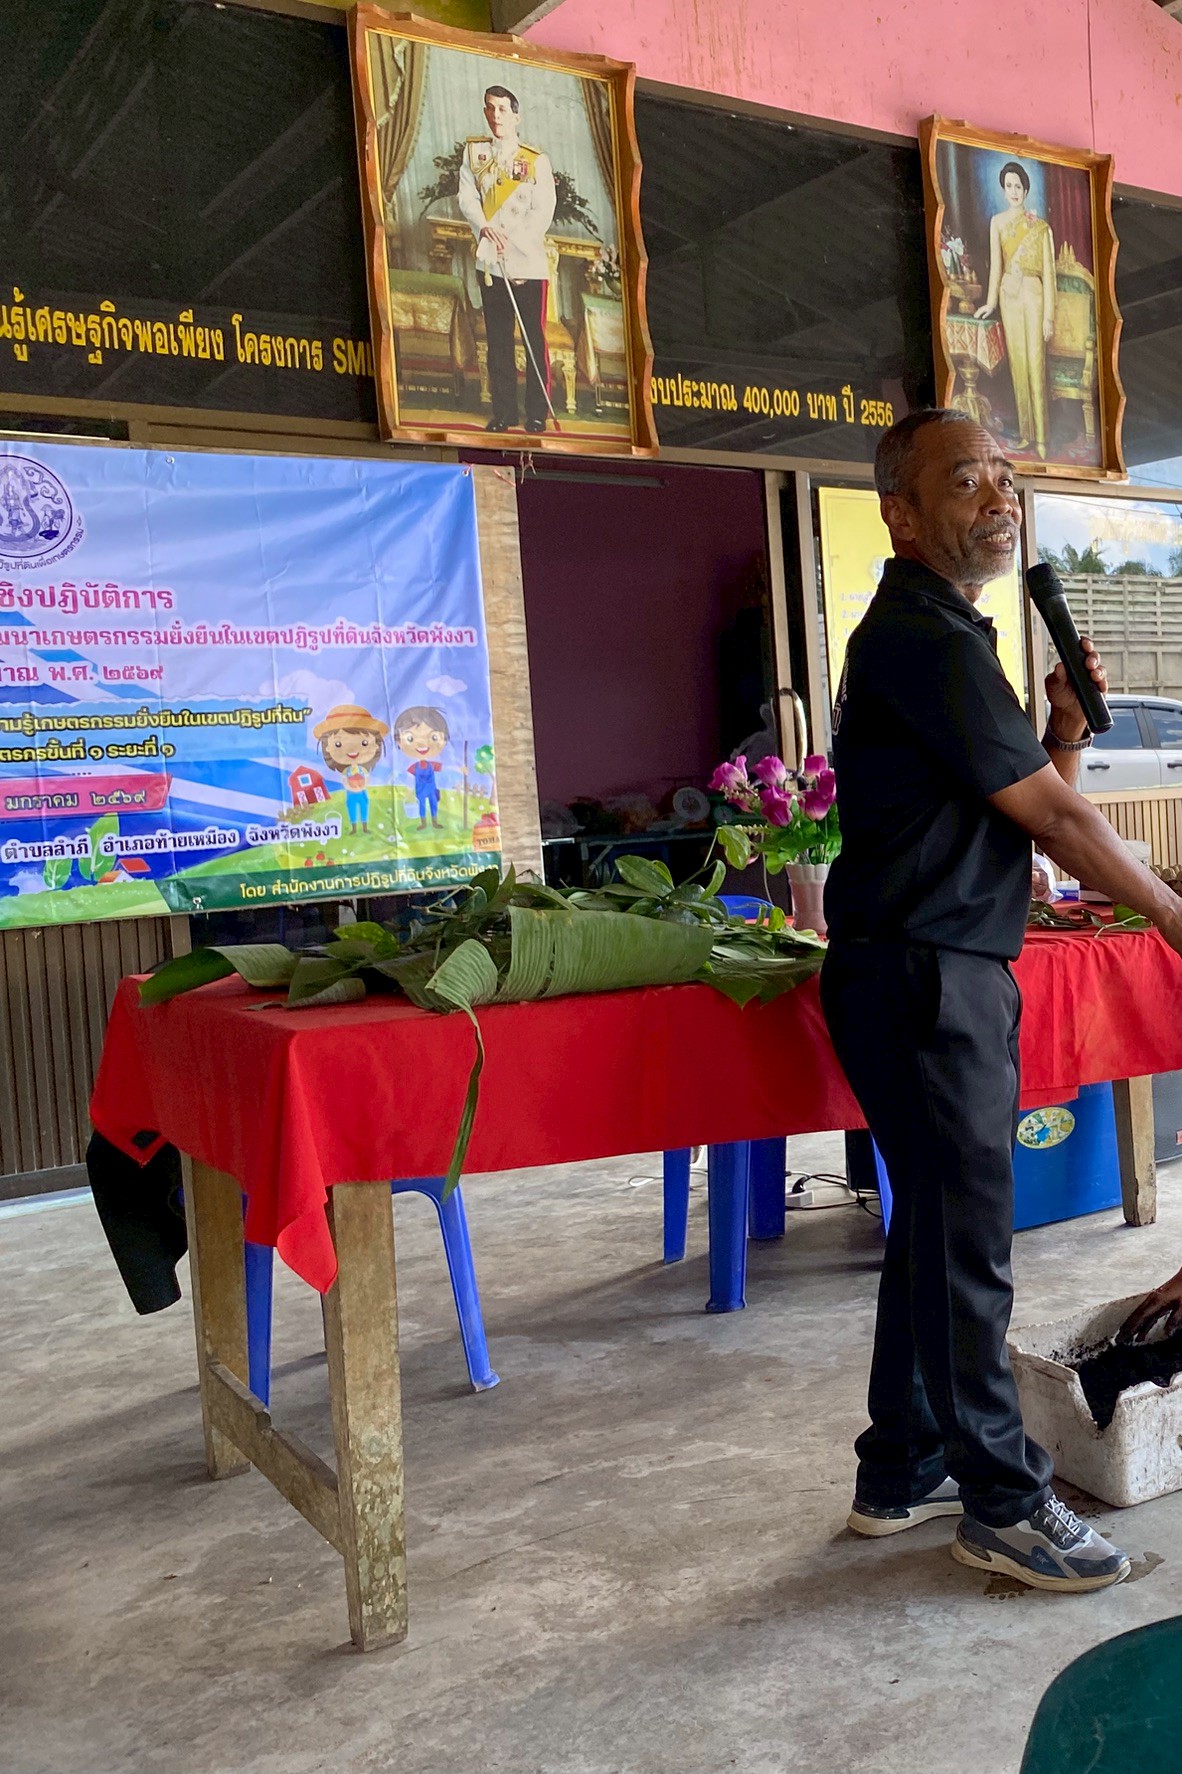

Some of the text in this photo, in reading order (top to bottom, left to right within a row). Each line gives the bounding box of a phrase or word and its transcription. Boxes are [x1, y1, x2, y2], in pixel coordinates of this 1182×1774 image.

[232, 313, 323, 371] โครงการ
[650, 373, 738, 411] งบประมาณ
[743, 386, 800, 418] 400,000
[807, 392, 837, 421] บาท
[842, 384, 854, 423] ปี
[861, 399, 894, 427] 2556
[0, 664, 164, 681] าณ พ.ศ. ๒๕๖๙
[90, 746, 104, 760] ๑
[108, 736, 158, 758] ระยะที่
[162, 744, 175, 758] ๑
[6, 790, 147, 810] มกราคม ๒๕๖๙
[5, 822, 339, 860] ตำบลลำภี อำเภอท้ายเหมือง จังหวัดพังงา
[240, 863, 499, 899] โดย สำนักงานการปฏิรูปที่ดินจังหวัดพั
